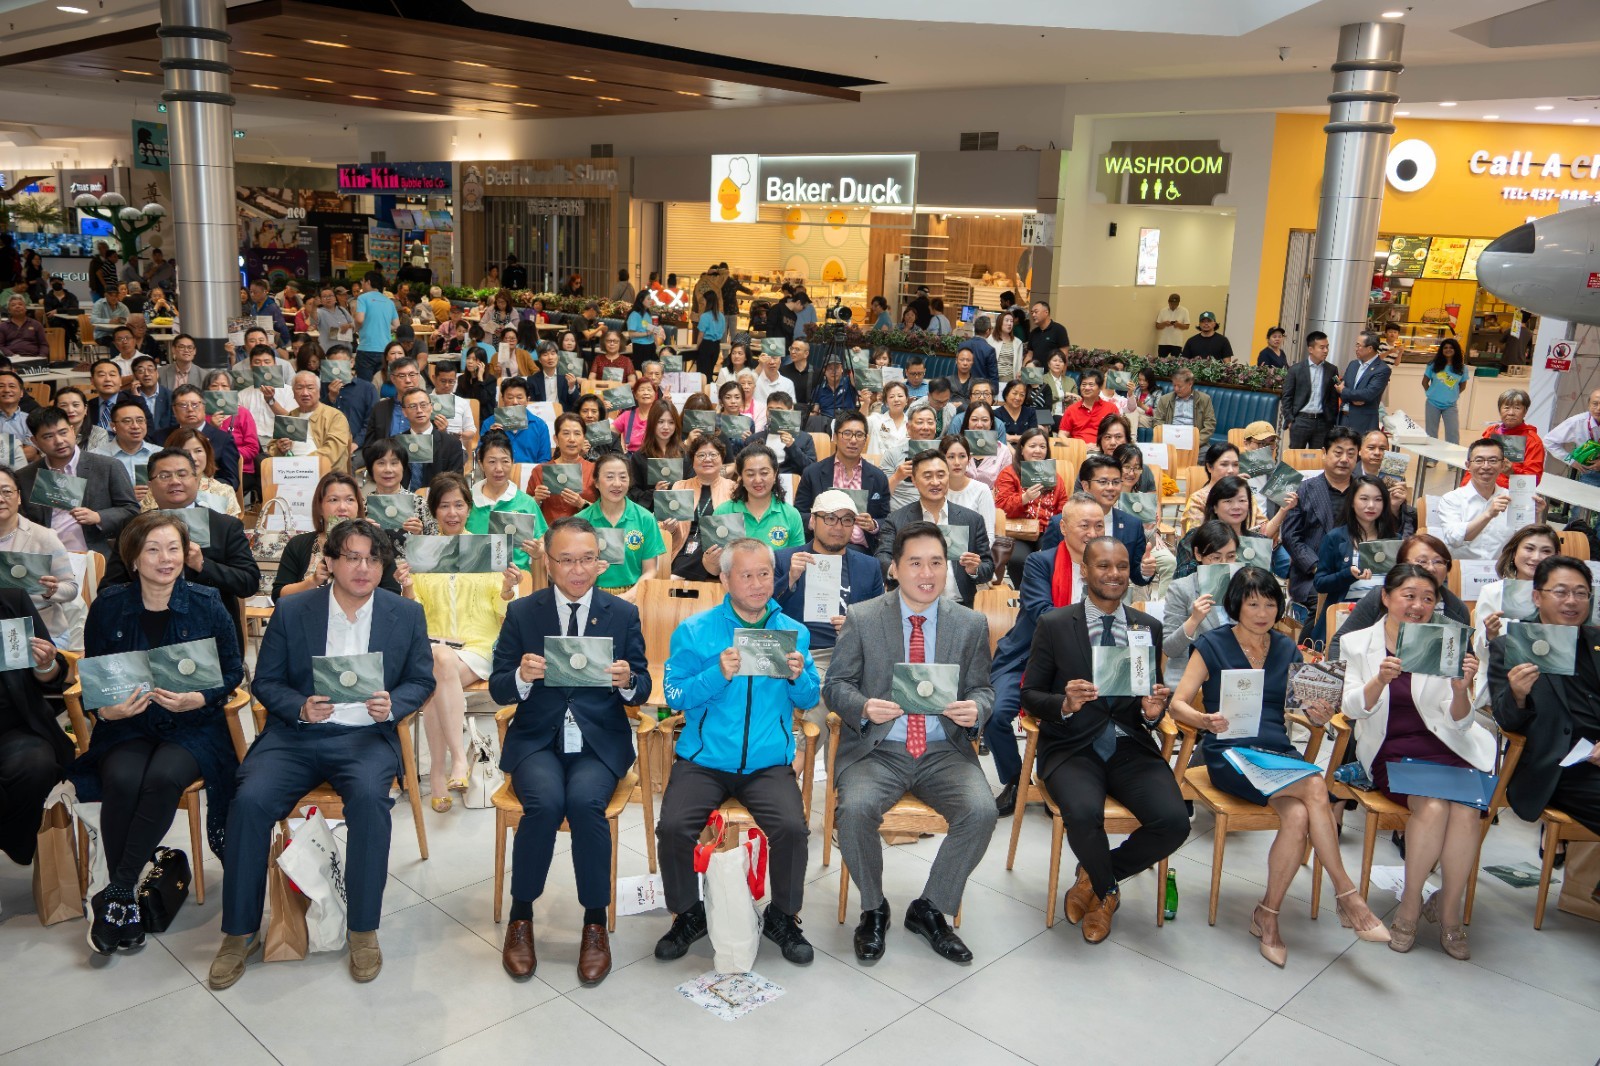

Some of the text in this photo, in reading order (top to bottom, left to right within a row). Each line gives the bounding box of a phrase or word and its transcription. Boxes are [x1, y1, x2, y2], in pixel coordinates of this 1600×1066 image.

[1104, 156, 1223, 174] WASHROOM
[1469, 150, 1532, 176] Call
[1541, 153, 1561, 178] A
[339, 168, 399, 188] Kin-Kin
[401, 178, 421, 188] Bubble
[423, 178, 433, 188] Tea
[485, 166, 519, 185] Beef
